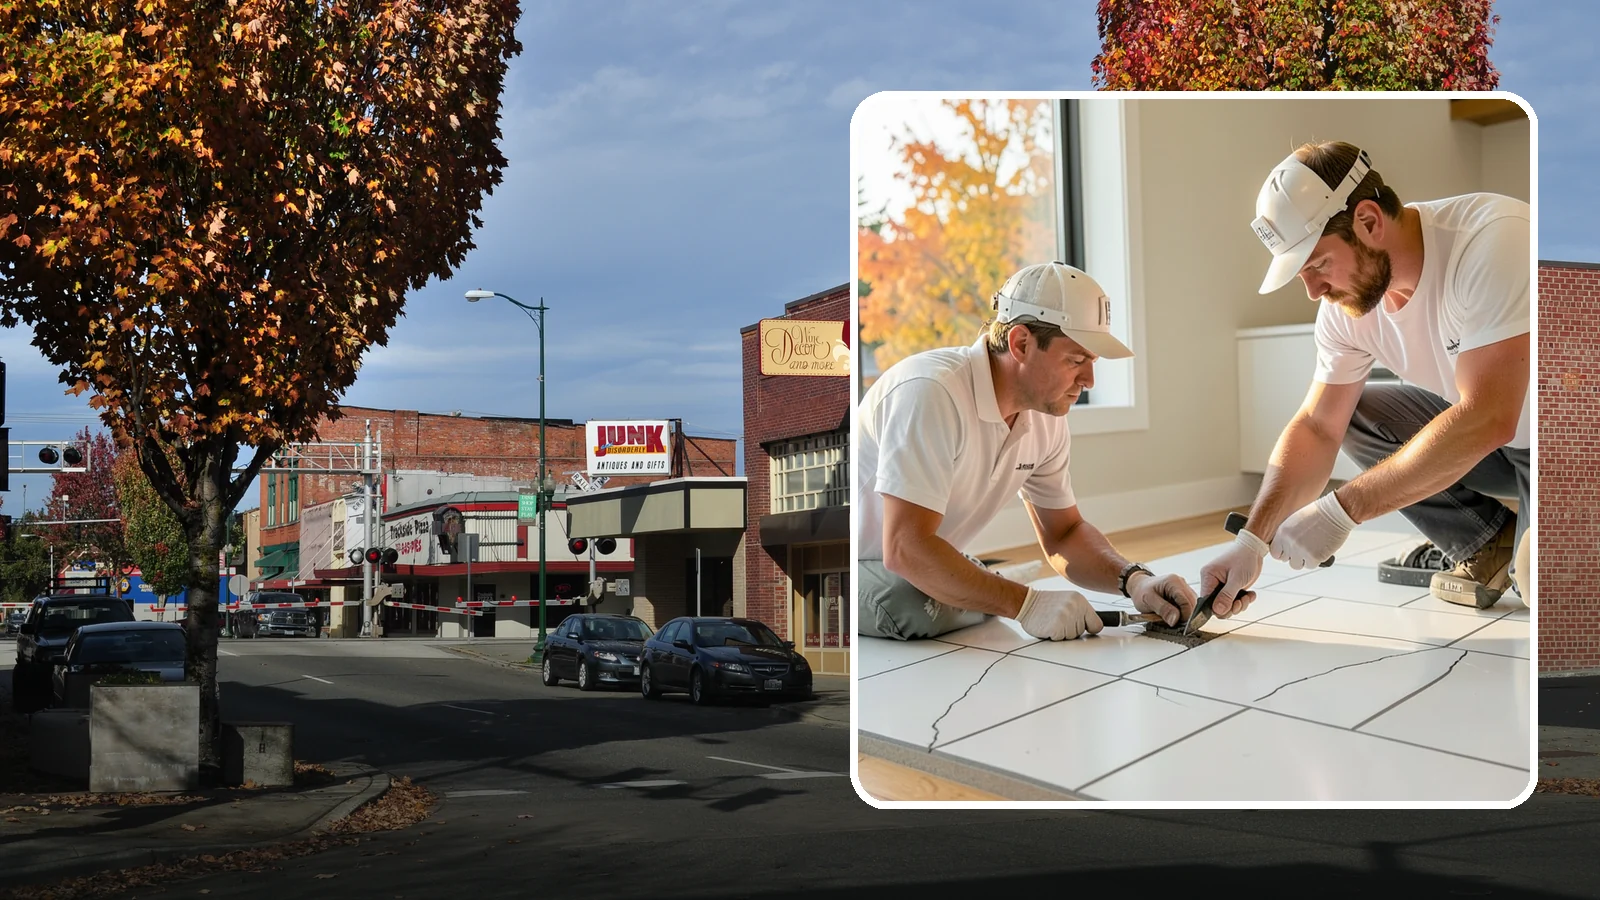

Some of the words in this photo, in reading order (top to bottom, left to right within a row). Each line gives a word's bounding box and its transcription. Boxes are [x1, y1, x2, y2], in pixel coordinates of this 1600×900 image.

[765, 327, 831, 365] Decor
[595, 425, 664, 457] JUNK
[607, 446, 646, 454] DISORDERLY
[597, 461, 628, 470] ANTIQUES
[631, 461, 643, 469] AND
[647, 460, 665, 469] GIFTS
[573, 473, 587, 491] RAIL
[590, 476, 608, 491] SING
